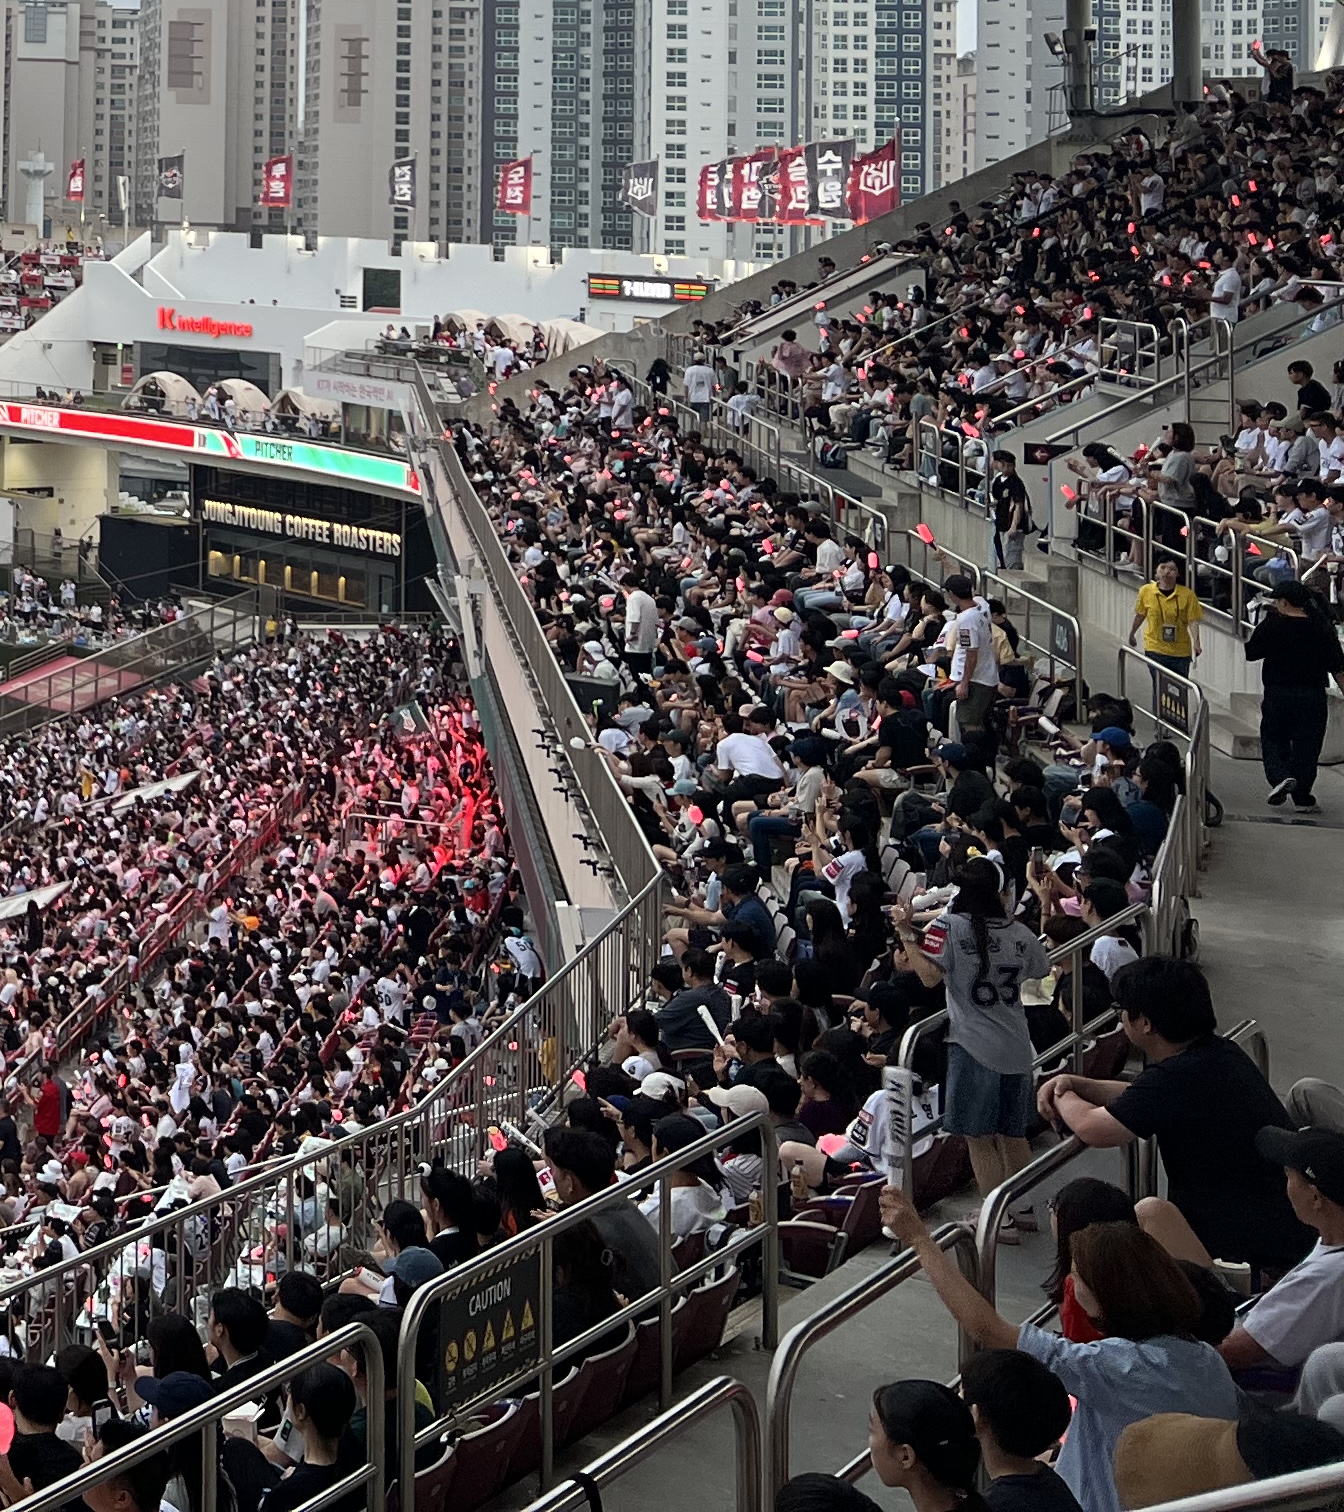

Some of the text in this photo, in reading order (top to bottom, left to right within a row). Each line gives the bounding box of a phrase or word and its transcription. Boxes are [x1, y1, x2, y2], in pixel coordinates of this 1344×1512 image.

[157, 306, 254, 338] K intelligence
[20, 407, 61, 429] PITCHER
[255, 439, 294, 463] PITCHER
[201, 499, 402, 557] JUNGJIYOUNG COFFEE ROASTERS
[971, 966, 1022, 1006] 63
[468, 1276, 512, 1317] CAUTION
